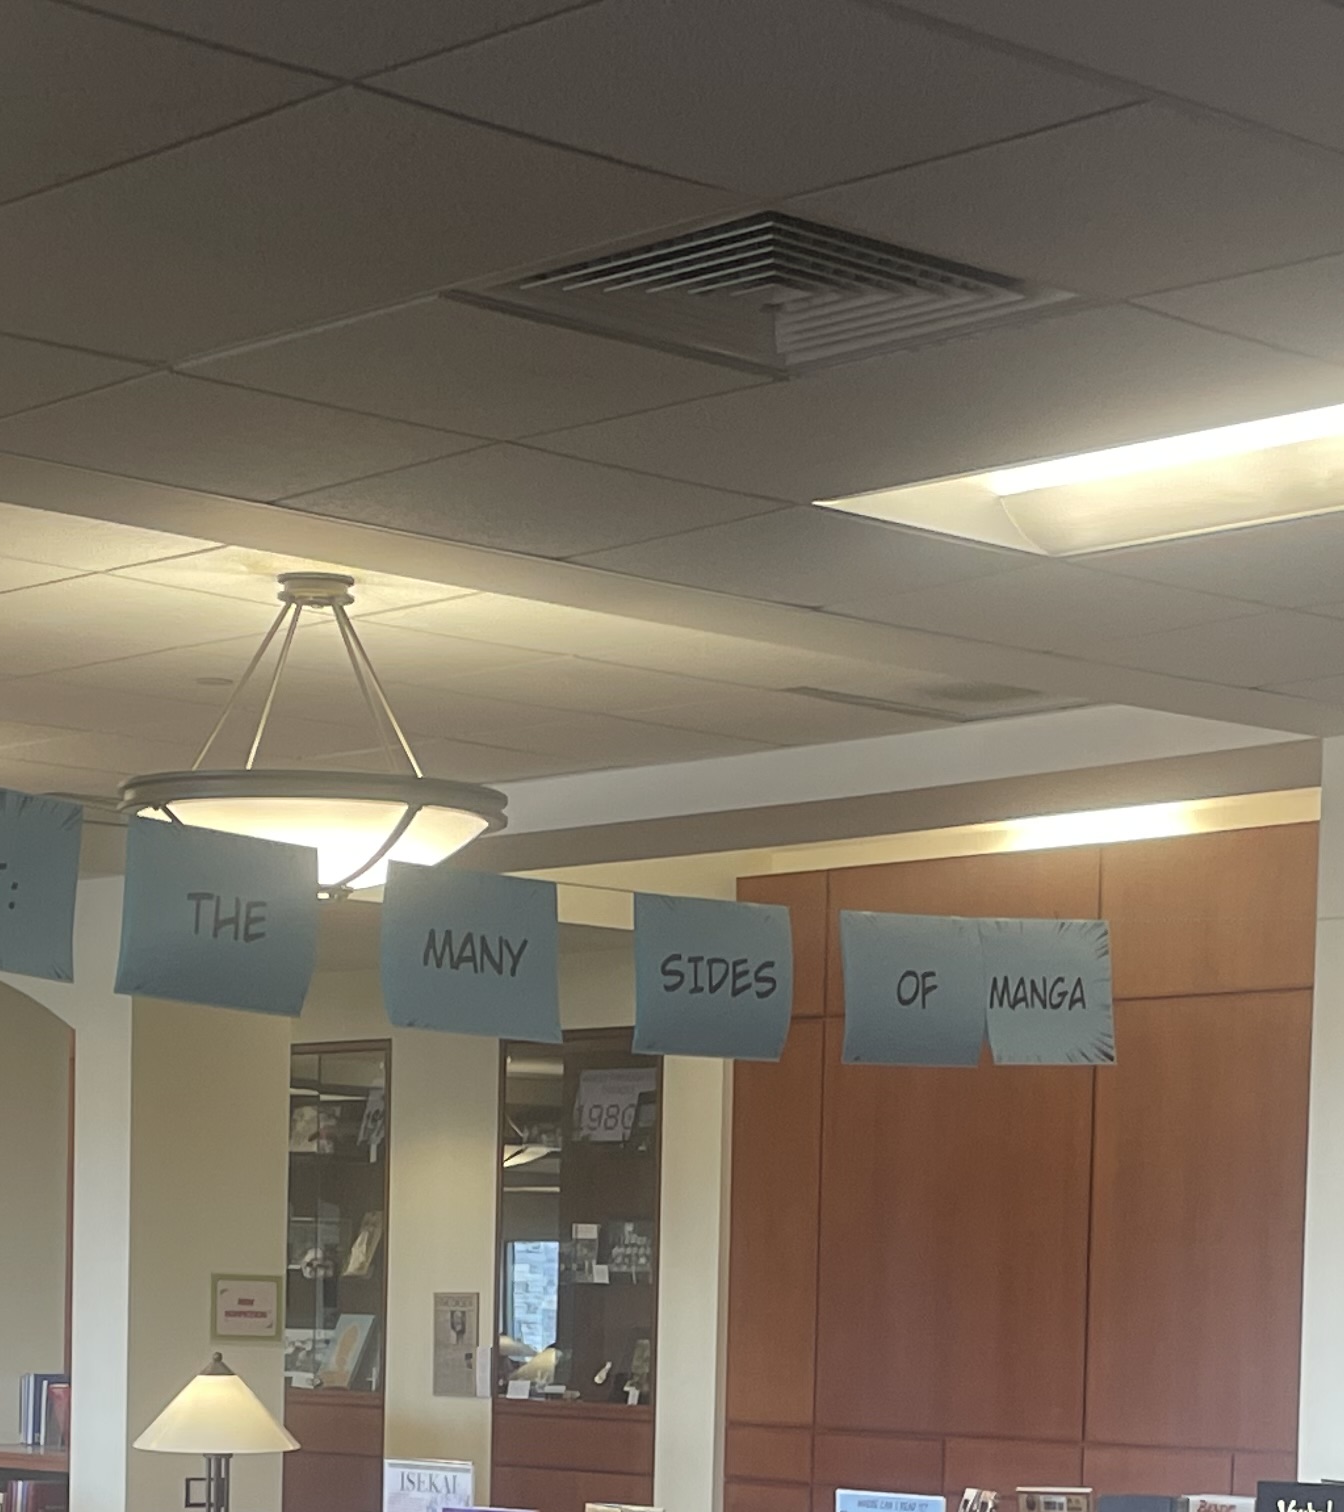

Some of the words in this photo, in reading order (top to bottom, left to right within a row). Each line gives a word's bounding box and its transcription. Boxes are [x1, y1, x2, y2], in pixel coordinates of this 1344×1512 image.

[186, 891, 268, 943] THE
[422, 927, 529, 978] MANY
[659, 953, 778, 1000] SIDES
[896, 969, 939, 1010] OF
[988, 975, 1087, 1010] MANGA
[399, 1470, 458, 1494] ISEKAI
